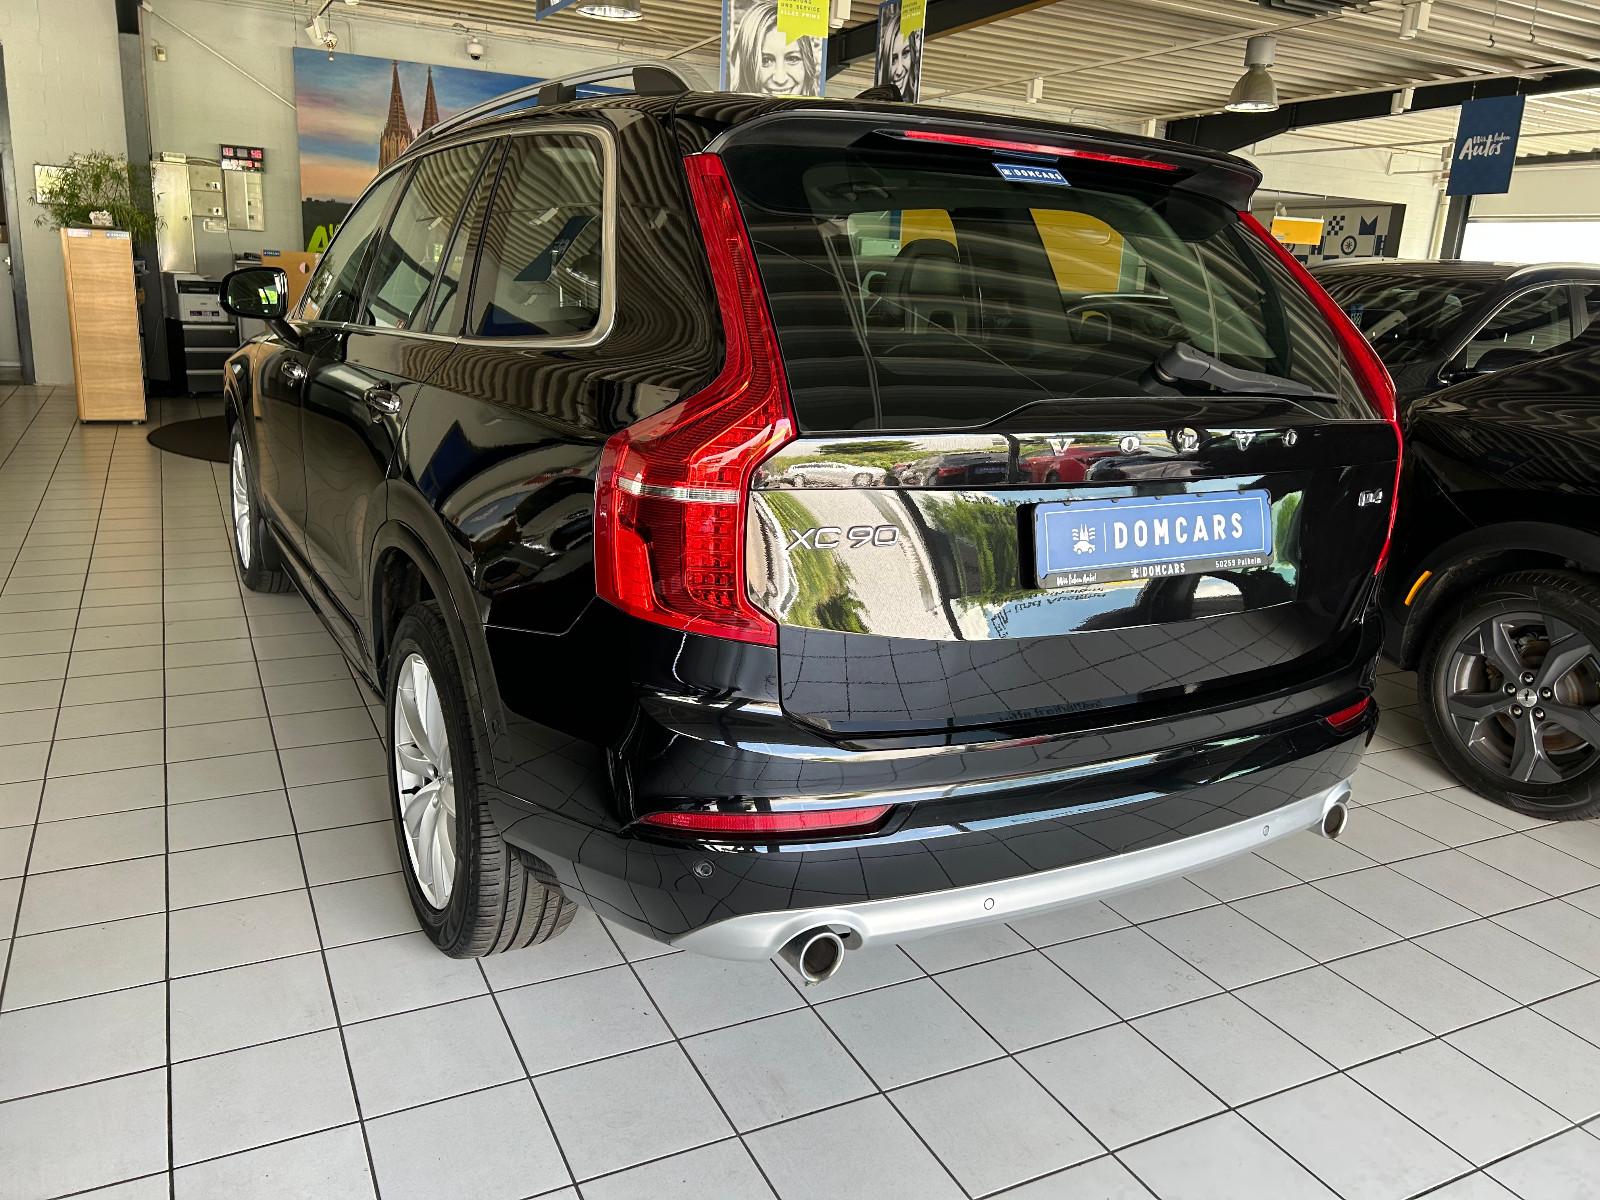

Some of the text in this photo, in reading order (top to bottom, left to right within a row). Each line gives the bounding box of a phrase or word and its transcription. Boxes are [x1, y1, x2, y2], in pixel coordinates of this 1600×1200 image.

[796, 4, 821, 13] SERVICE
[1458, 134, 1503, 160] Autos
[1014, 169, 1062, 180] DOMCARS
[1045, 428, 1298, 457] VOLVO
[1113, 512, 1244, 550] DOMCARS
[1141, 562, 1187, 578] DOMCARS
[1215, 559, 1236, 568] 50259
